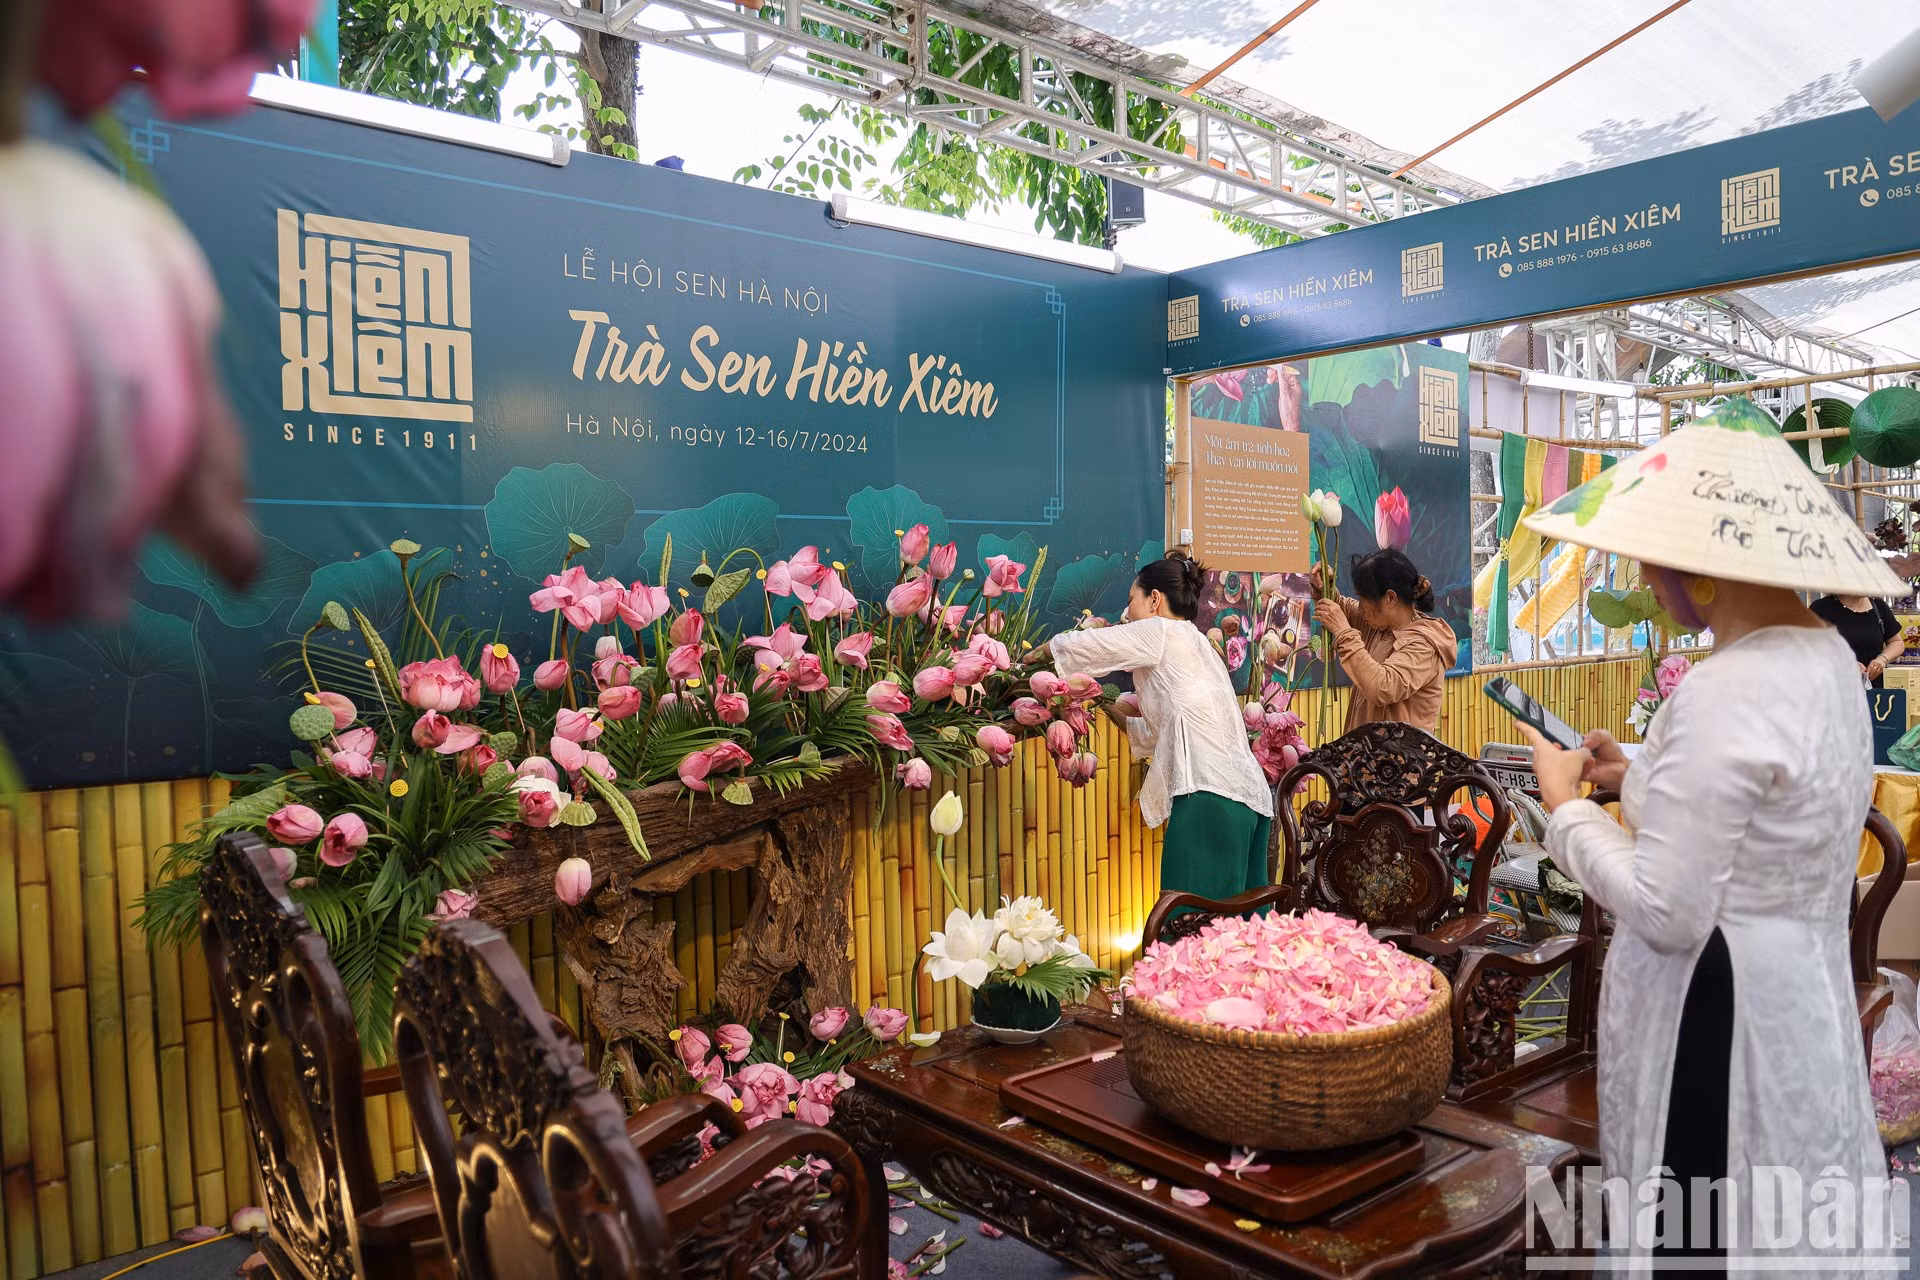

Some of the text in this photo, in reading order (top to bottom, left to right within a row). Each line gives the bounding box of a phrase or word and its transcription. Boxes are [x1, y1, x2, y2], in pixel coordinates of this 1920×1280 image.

[1824, 151, 1920, 189] TRÀ SE
[1886, 185, 1912, 200] 085
[1474, 203, 1681, 262] TRÀ SEN HIỀN XIÊM
[1721, 227, 1781, 244] SINCE 1911
[1516, 261, 1534, 272] 085
[1536, 257, 1554, 269] 888
[1556, 253, 1577, 265] 1976
[1586, 247, 1610, 259] 0915
[1611, 243, 1624, 254] 63
[1626, 238, 1652, 251] 8686
[564, 247, 828, 317] LỄ HỘI SEN HÀ NỘI
[1221, 268, 1373, 313] TRÀ SEN HIỀN XIÊM
[1253, 313, 1266, 323] 085
[1304, 304, 1321, 313] 0915
[1323, 302, 1332, 310] 63
[1334, 298, 1352, 308] 8686
[568, 309, 998, 419] Trà Sen Hiền Xiêm
[283, 423, 476, 451] SINCE 1911
[566, 413, 868, 453] Hà Nội, ngày 12-16/7/2024
[1205, 433, 1222, 450] Một
[1274, 442, 1290, 457] hoa
[1419, 446, 1459, 458] SINCE 1911
[1497, 770, 1539, 788] F-H8-9
